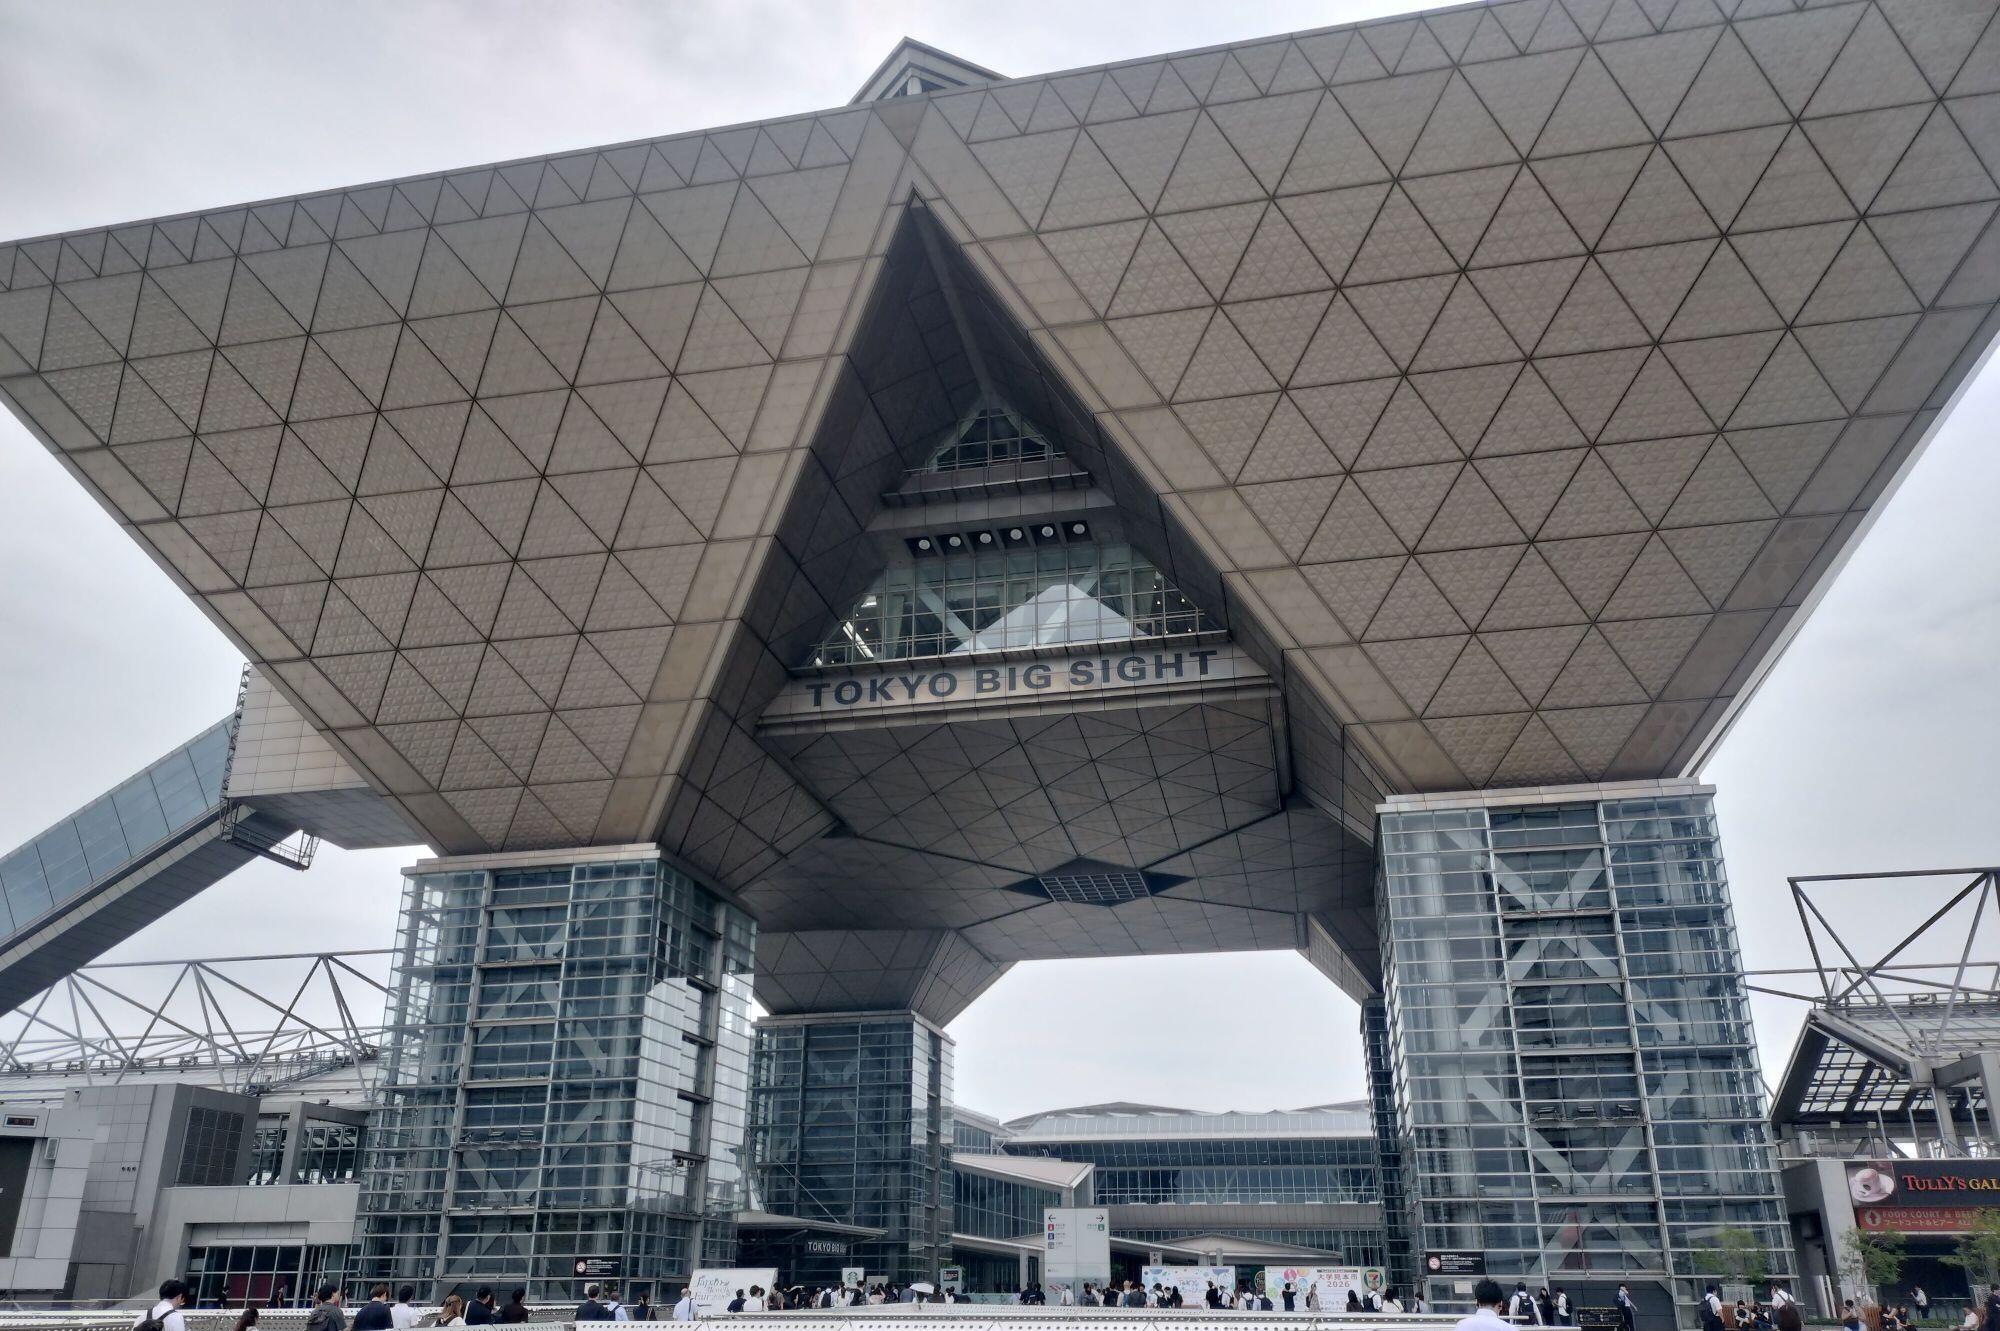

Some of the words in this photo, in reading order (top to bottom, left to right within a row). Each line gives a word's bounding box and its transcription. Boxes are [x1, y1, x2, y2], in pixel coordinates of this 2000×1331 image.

[806, 672, 958, 707] TOKYO
[976, 664, 1052, 694] BIG
[1070, 650, 1217, 686] SIGHT
[1902, 1175, 1967, 1191] TULLY'S
[1882, 1210, 1906, 1218] FOOD
[1910, 1210, 1940, 1218] COURT
[808, 1241, 830, 1252] TOKYO
[1317, 1273, 1358, 1281] 大学見本市
